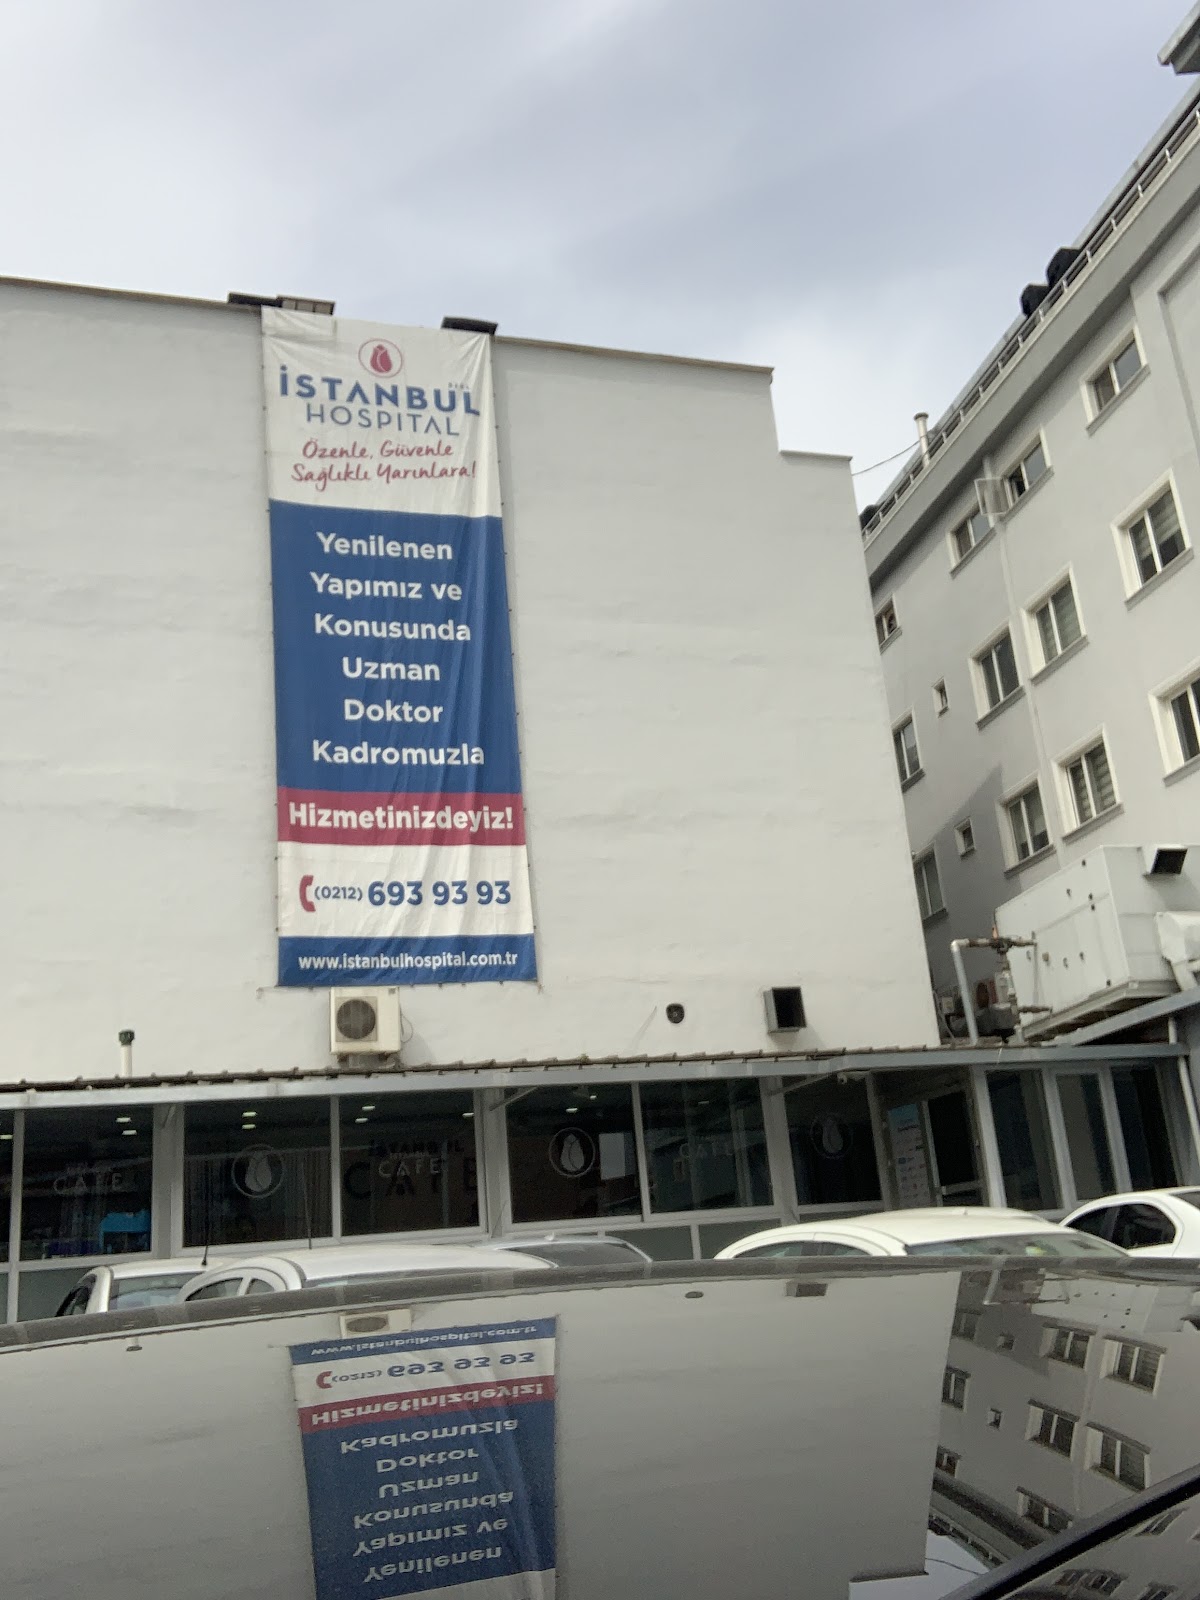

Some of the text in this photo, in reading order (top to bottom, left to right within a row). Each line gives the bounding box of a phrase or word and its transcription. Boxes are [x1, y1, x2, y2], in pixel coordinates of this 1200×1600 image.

[306, 403, 460, 436] HOSPITAL
[302, 437, 454, 459] Özenle, Güvenle
[290, 461, 477, 492] Sağlıklı Yarınlara!
[315, 531, 453, 560] Yenilenen
[309, 571, 463, 601] Yapımız ve
[314, 613, 471, 641] Konusunda
[342, 656, 441, 681] Uzman
[343, 698, 443, 723] Doktor
[312, 739, 485, 765] Kadromuzla
[288, 801, 514, 833] Hizmetinizdeyiz!
[314, 880, 512, 906] (0212) 693 93 93
[298, 951, 518, 970] www.istanbulhospital.com.tr
